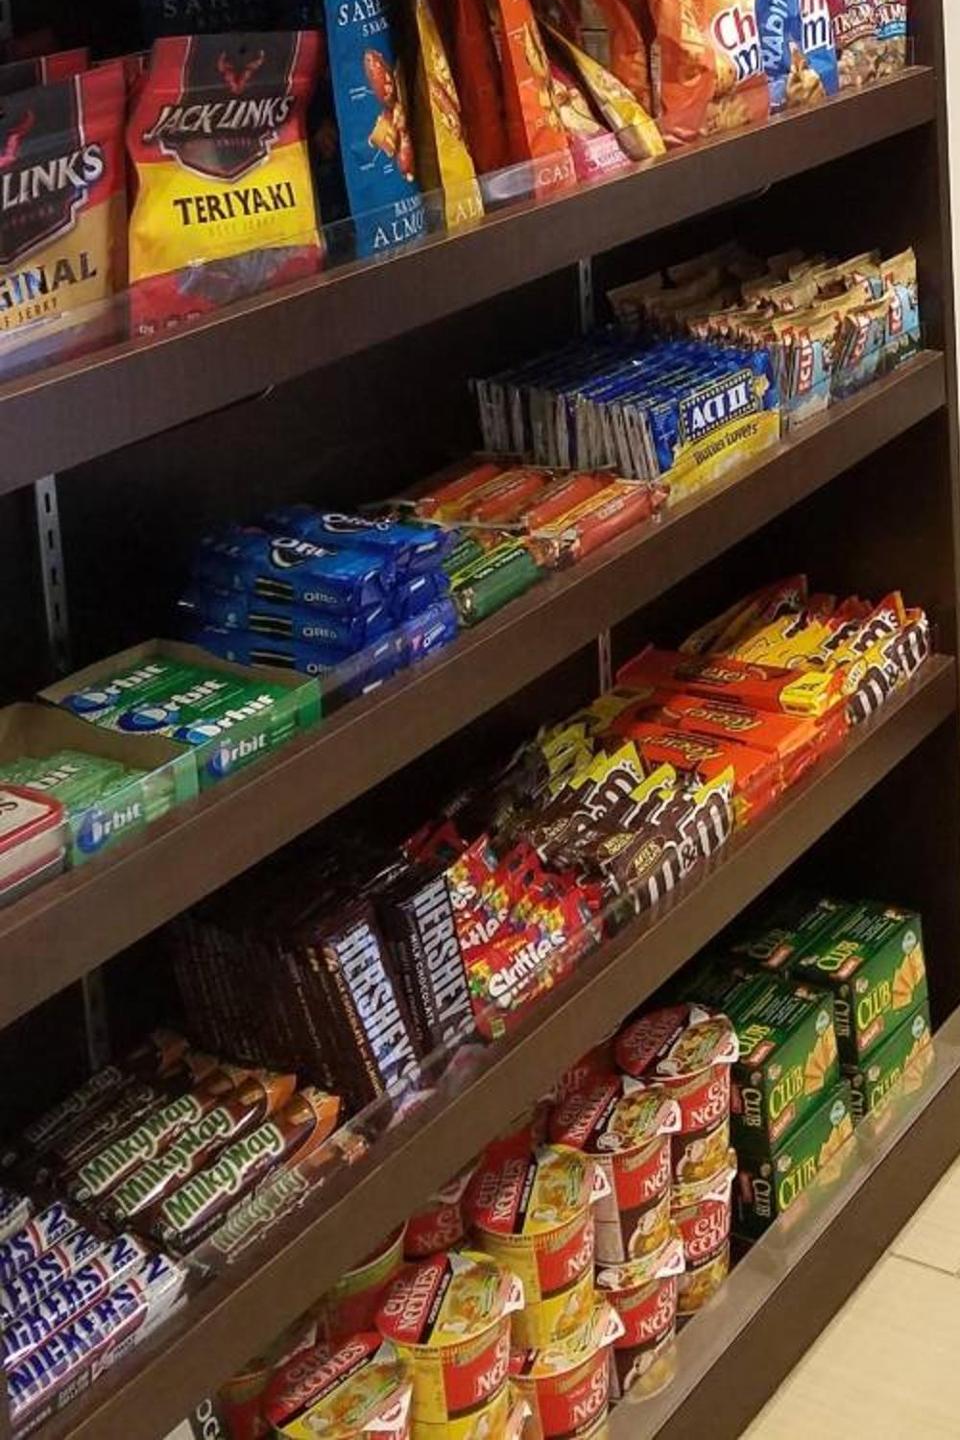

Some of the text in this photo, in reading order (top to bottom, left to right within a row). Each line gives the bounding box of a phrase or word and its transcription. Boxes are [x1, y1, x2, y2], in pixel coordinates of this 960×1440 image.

[143, 102, 217, 140] JACK
[173, 182, 296, 226] TERIYAKI
[373, 209, 425, 249] ALMO
[0, 252, 98, 309] GINAL
[692, 384, 750, 432] ACT II
[413, 879, 476, 1050] HERSHEY'S
[857, 979, 892, 1031] CLUB
[769, 1064, 804, 1120] CLUB
[779, 1155, 818, 1211] CLUB
